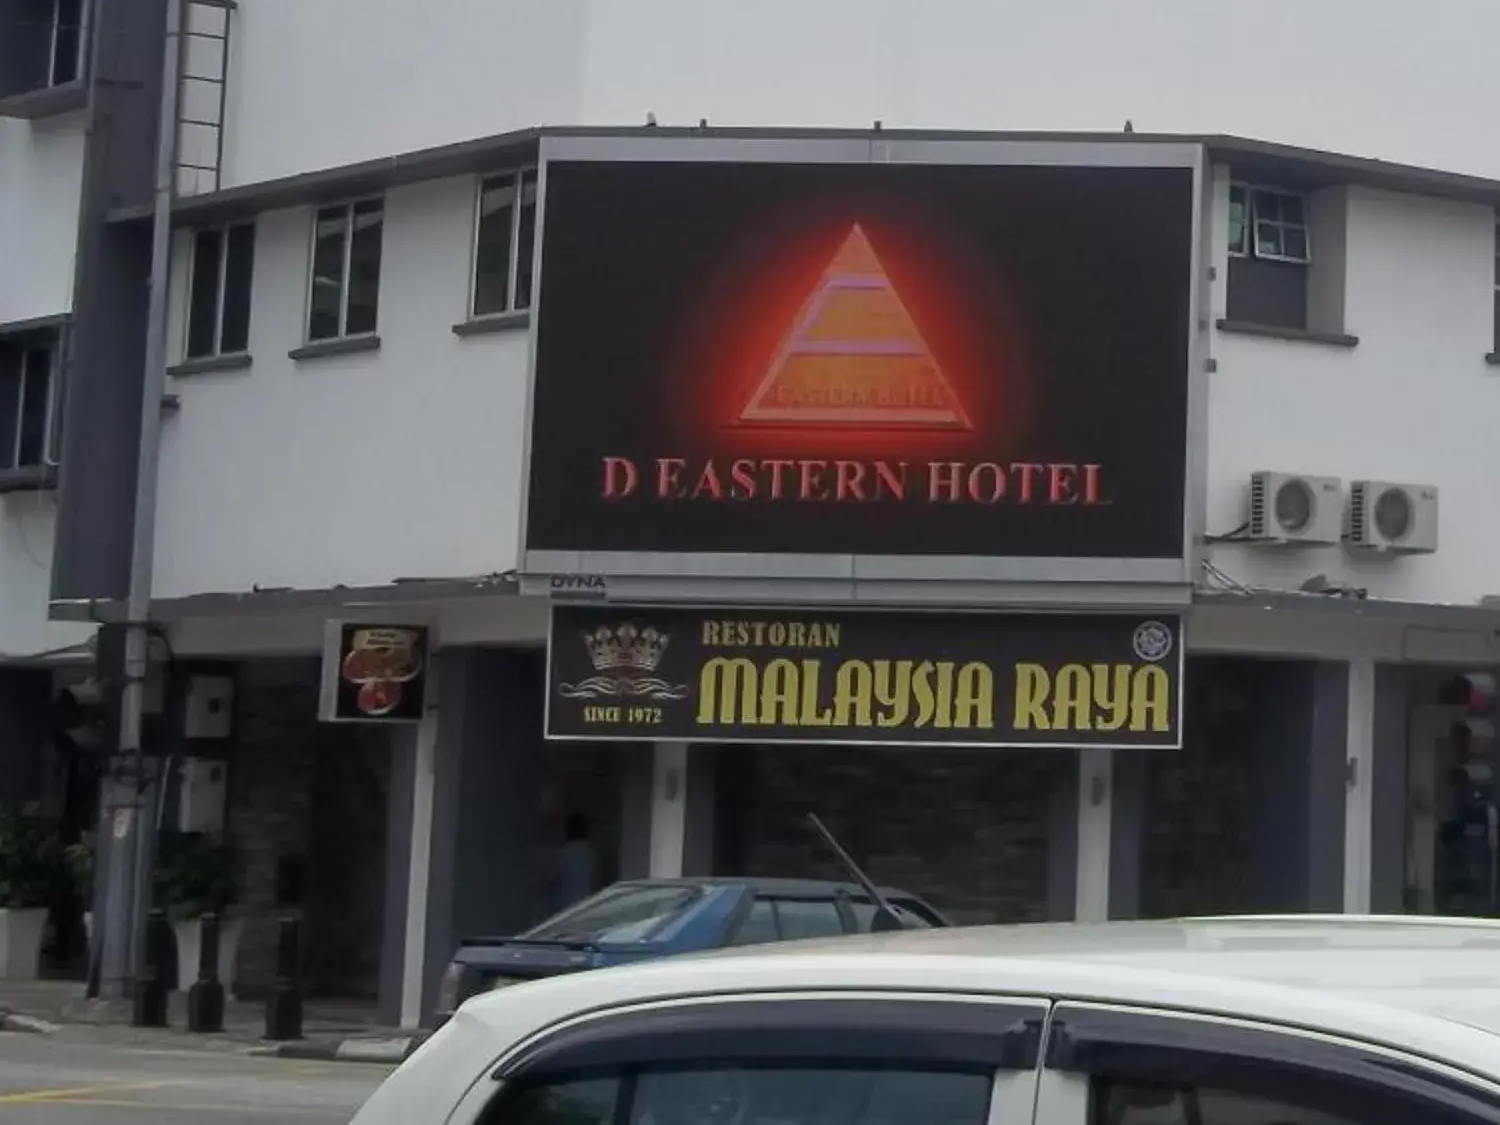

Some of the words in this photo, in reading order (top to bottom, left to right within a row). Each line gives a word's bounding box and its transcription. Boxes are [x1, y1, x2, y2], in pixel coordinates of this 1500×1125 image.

[601, 456, 638, 497] D
[656, 458, 910, 502] EASTERN
[928, 461, 1114, 506] HOTEL
[551, 576, 606, 588] DYNA
[702, 620, 840, 648] RESTORAN
[696, 656, 993, 728] MALAYSIA
[1013, 663, 1169, 732] RAYA
[583, 706, 621, 722] SINCE
[628, 708, 662, 723] 1972
